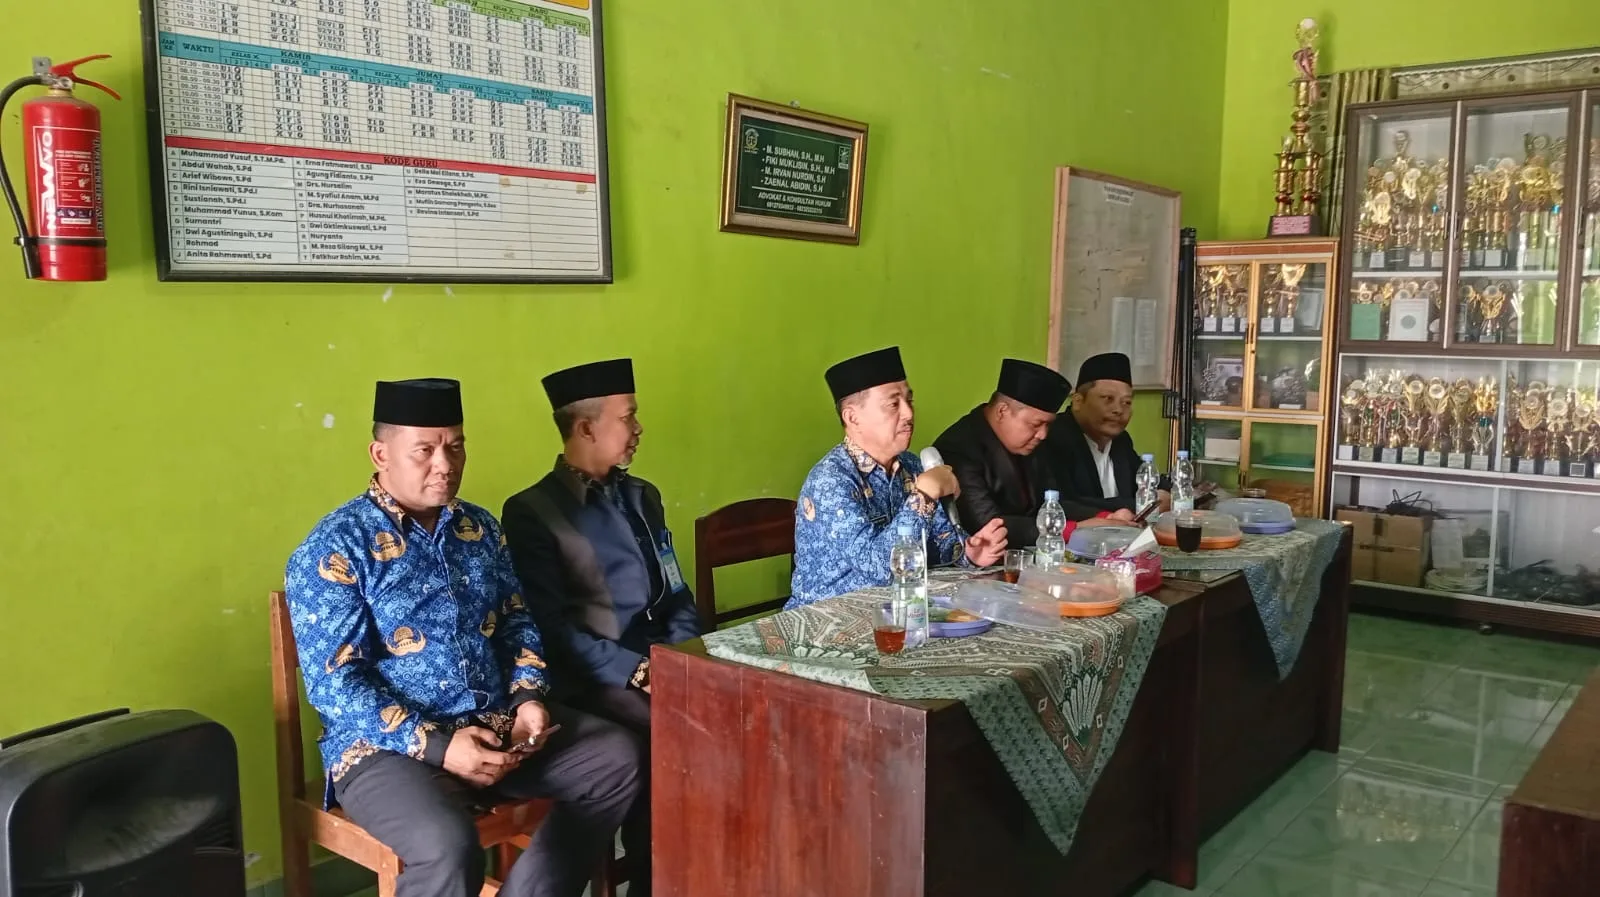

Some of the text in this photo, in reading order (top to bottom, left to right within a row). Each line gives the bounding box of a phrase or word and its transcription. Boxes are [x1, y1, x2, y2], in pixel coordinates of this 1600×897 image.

[182, 42, 214, 53] WAKTU
[181, 150, 228, 159] Muhammad
[766, 144, 773, 154] M.
[774, 146, 800, 160] SUBHAN,
[206, 163, 236, 172] Wahab,
[384, 156, 438, 168] KODE GURU
[766, 155, 778, 166] FIKI
[824, 165, 835, 175] M.H
[307, 171, 329, 179] Agung
[765, 166, 826, 184] M. IRVAN NURDIN, S.H
[764, 176, 823, 192] ZAENAL ABIDIN, S.H
[758, 191, 781, 200] ADVOKAT
[787, 196, 814, 206] KONSULTAN
[184, 206, 231, 214] Muhammad
